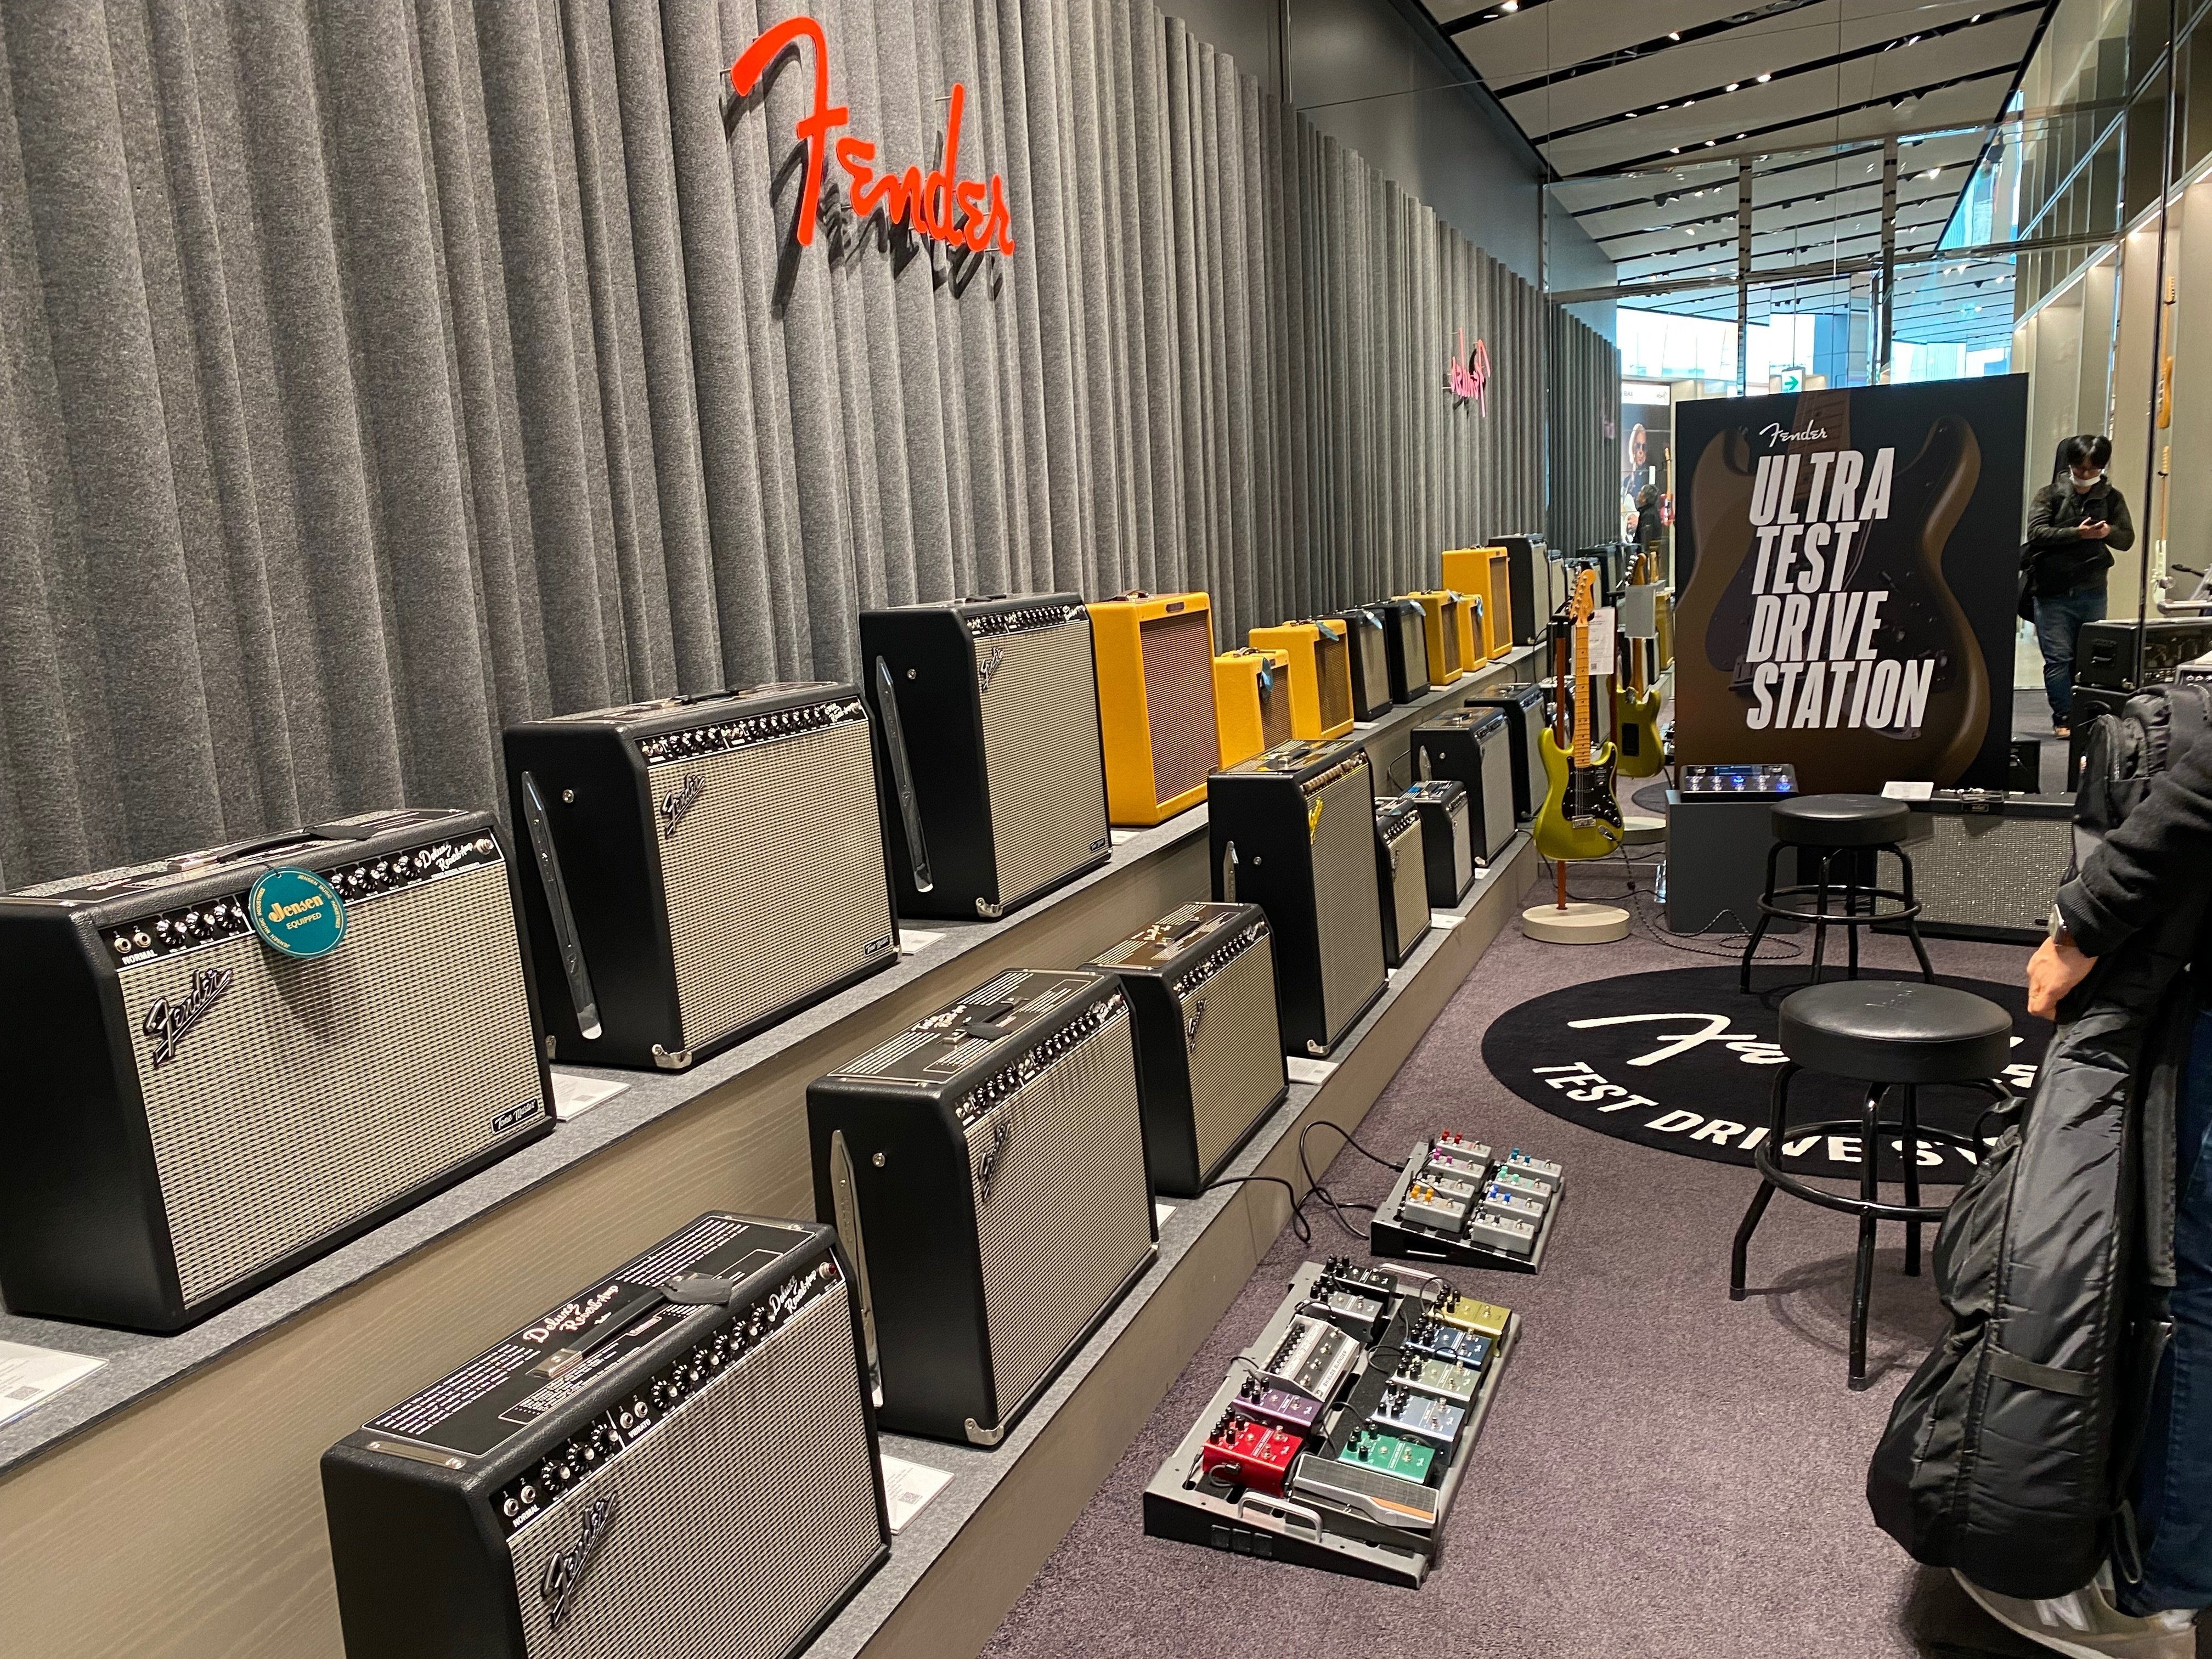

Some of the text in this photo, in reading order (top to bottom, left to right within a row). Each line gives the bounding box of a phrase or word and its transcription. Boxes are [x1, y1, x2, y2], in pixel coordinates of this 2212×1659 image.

[731, 15, 1014, 256] Fender
[1759, 420, 1827, 448] Fender
[1749, 447, 1895, 526] ULTRA
[1751, 521, 1860, 595] TEST
[1746, 591, 1888, 663] DRIVE
[1746, 659, 1934, 730] STATION
[660, 772, 706, 839] Fender
[268, 895, 324, 922] Jensen
[285, 912, 322, 930] EQUIPPED
[121, 949, 158, 965] NORMAL
[143, 969, 234, 1066] Fender
[1532, 1062, 1659, 1113] TEST
[494, 1101, 536, 1130] Tone Master
[1644, 1109, 1862, 1162] DRIVE
[522, 1303, 581, 1344] Deluxe
[1323, 1350, 1348, 1387] SHIELDS BLENDER
[628, 1418, 652, 1438] VIBRATO
[512, 1504, 540, 1528] NORMAL
[540, 1491, 618, 1628] Fender
